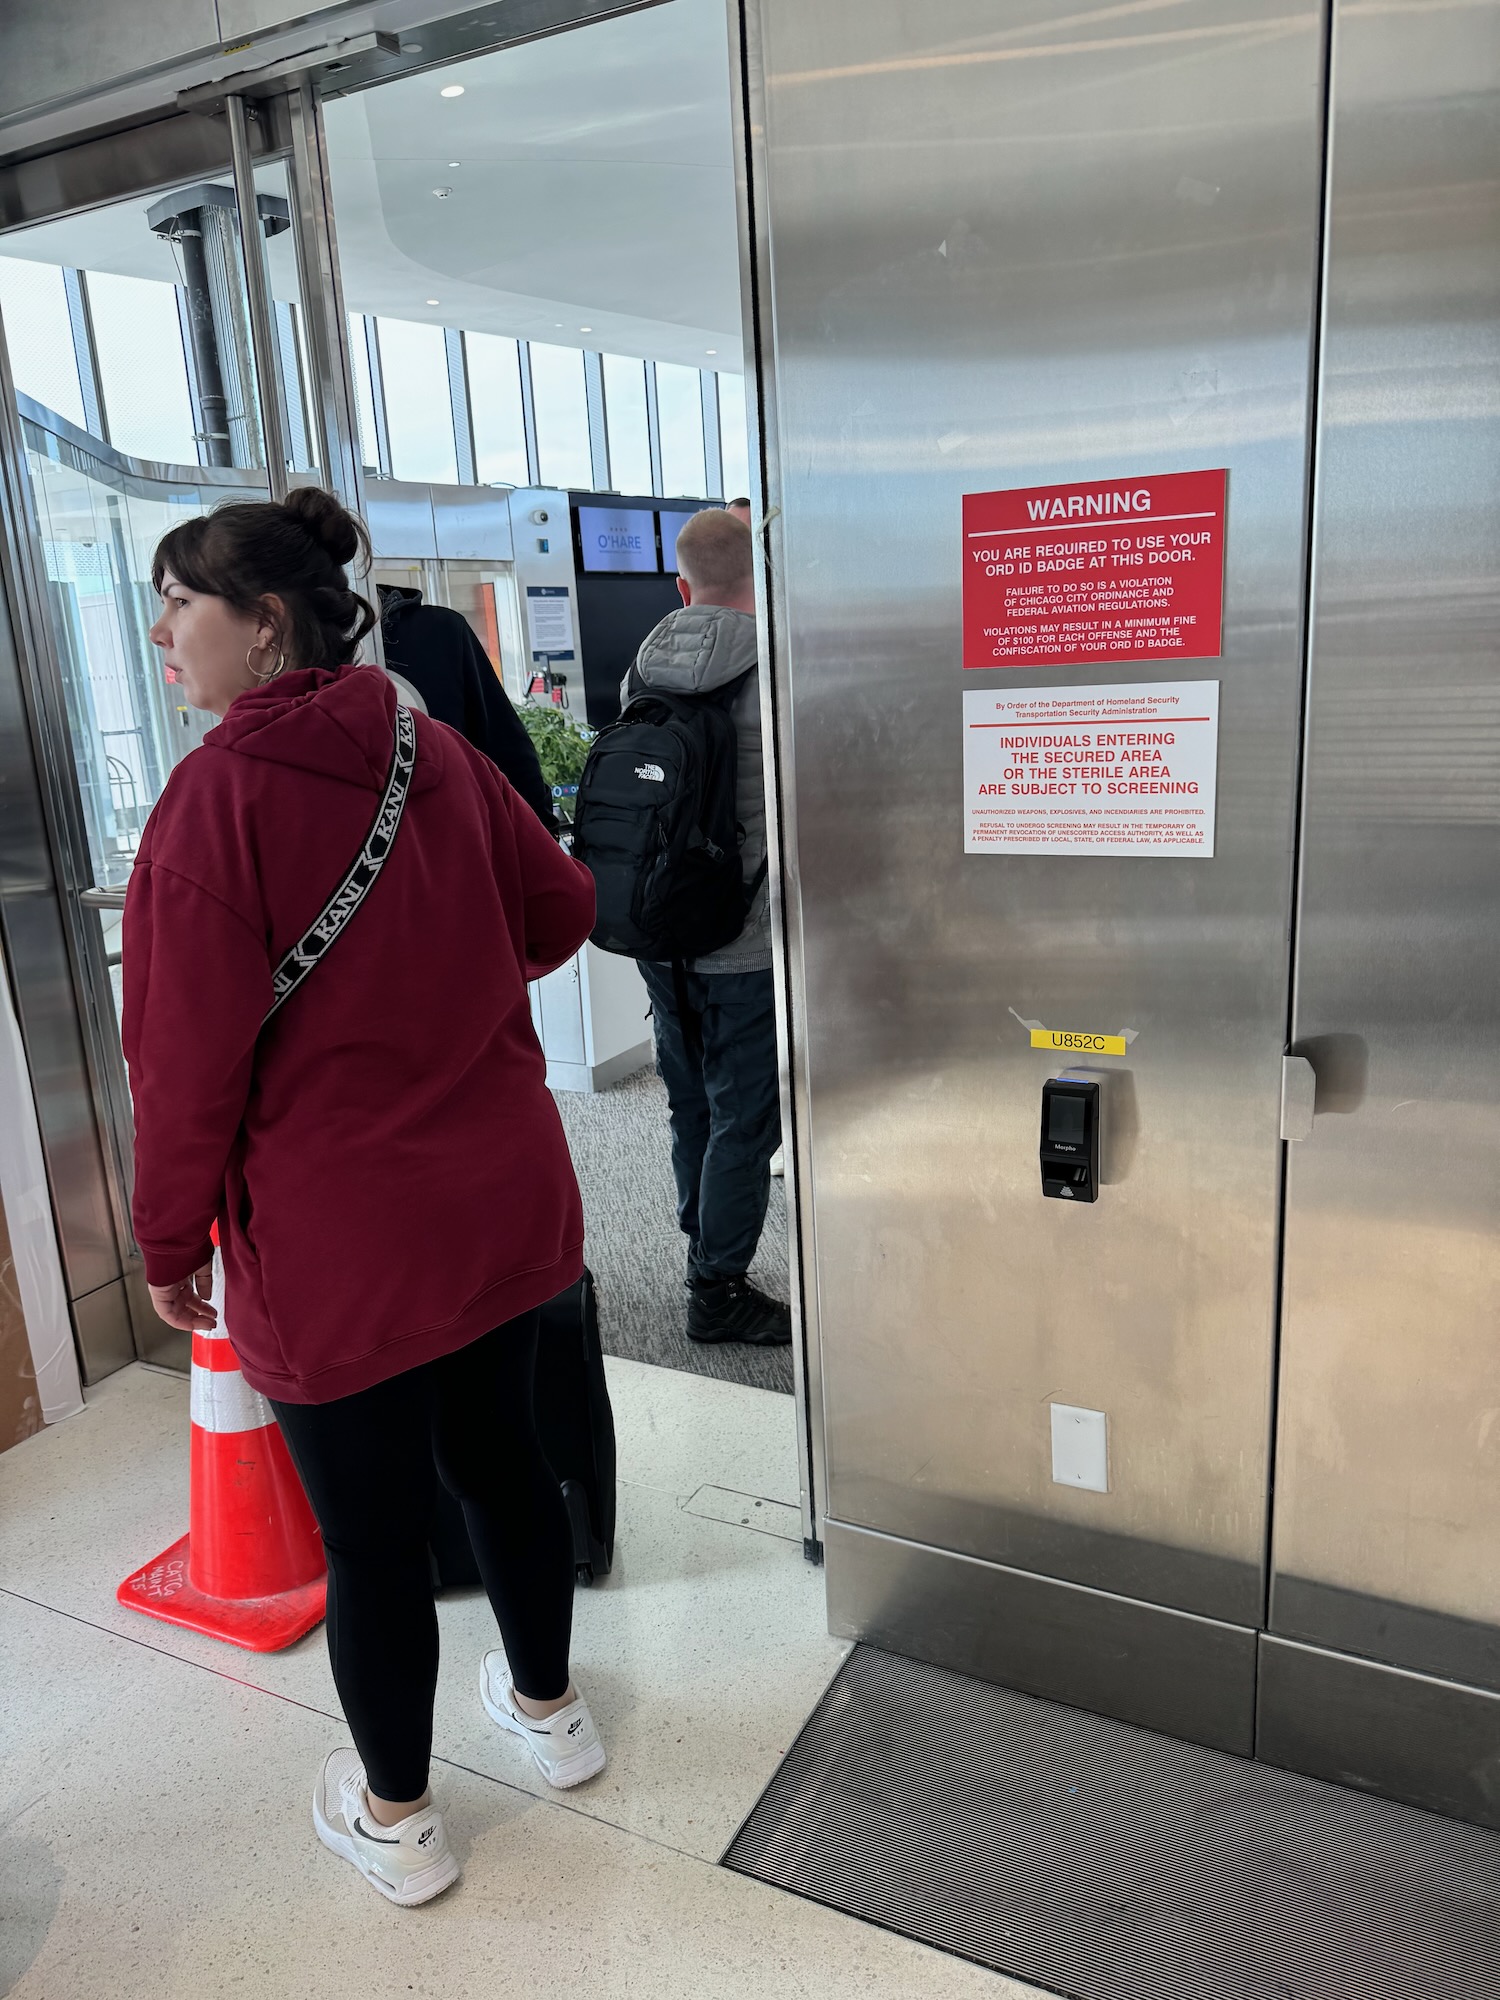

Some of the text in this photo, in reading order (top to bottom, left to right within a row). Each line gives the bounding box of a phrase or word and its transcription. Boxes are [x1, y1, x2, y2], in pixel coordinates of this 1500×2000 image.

[1026, 489, 1151, 521] WARNING
[598, 534, 642, 549] O'HARE
[972, 531, 1211, 563] YOU ARE REQUIRED TO USE YOUR
[985, 549, 1196, 577] ORD ID BADGE AT THIS DOOR.
[1006, 576, 1172, 597] FAILURE TO DO SO IS A VIOLATION
[1003, 587, 1174, 607] OF CHICAGO CITY ORDINANCE AND
[1006, 598, 1171, 617] FEDERAL AVIATION REGULATIONS.
[983, 615, 1197, 637] VIOLATIONS MAY RESULT IN A MINIMUM FINE
[997, 627, 1180, 646] OF $100 FOR EACH OFFENSE AND THE
[992, 637, 1185, 656] CONFISCATION OF YOUR ORD ID BADGE.
[995, 702, 1006, 711] By
[1006, 702, 1028, 710] Order
[1029, 701, 1037, 709] of
[1051, 699, 1095, 709] Department
[1096, 698, 1105, 706] of
[1106, 697, 1146, 706] Homeland
[1147, 696, 1180, 705] Security
[1015, 706, 1158, 719] Transportation Security Administration
[1000, 732, 1175, 749] INDIVIDUALS ENTERING
[1010, 749, 1162, 764] THE SECURED AREA
[634, 766, 656, 776] NORTH
[1003, 765, 1171, 780] OR THE STERILE AREA
[978, 781, 1199, 795] ARE SUBJECT TO SCREENING
[376, 780, 405, 842] KANI
[313, 880, 365, 942] KANI
[273, 971, 294, 1002] NI
[1052, 1033, 1105, 1050] U852C
[1054, 1143, 1077, 1152] Morpho
